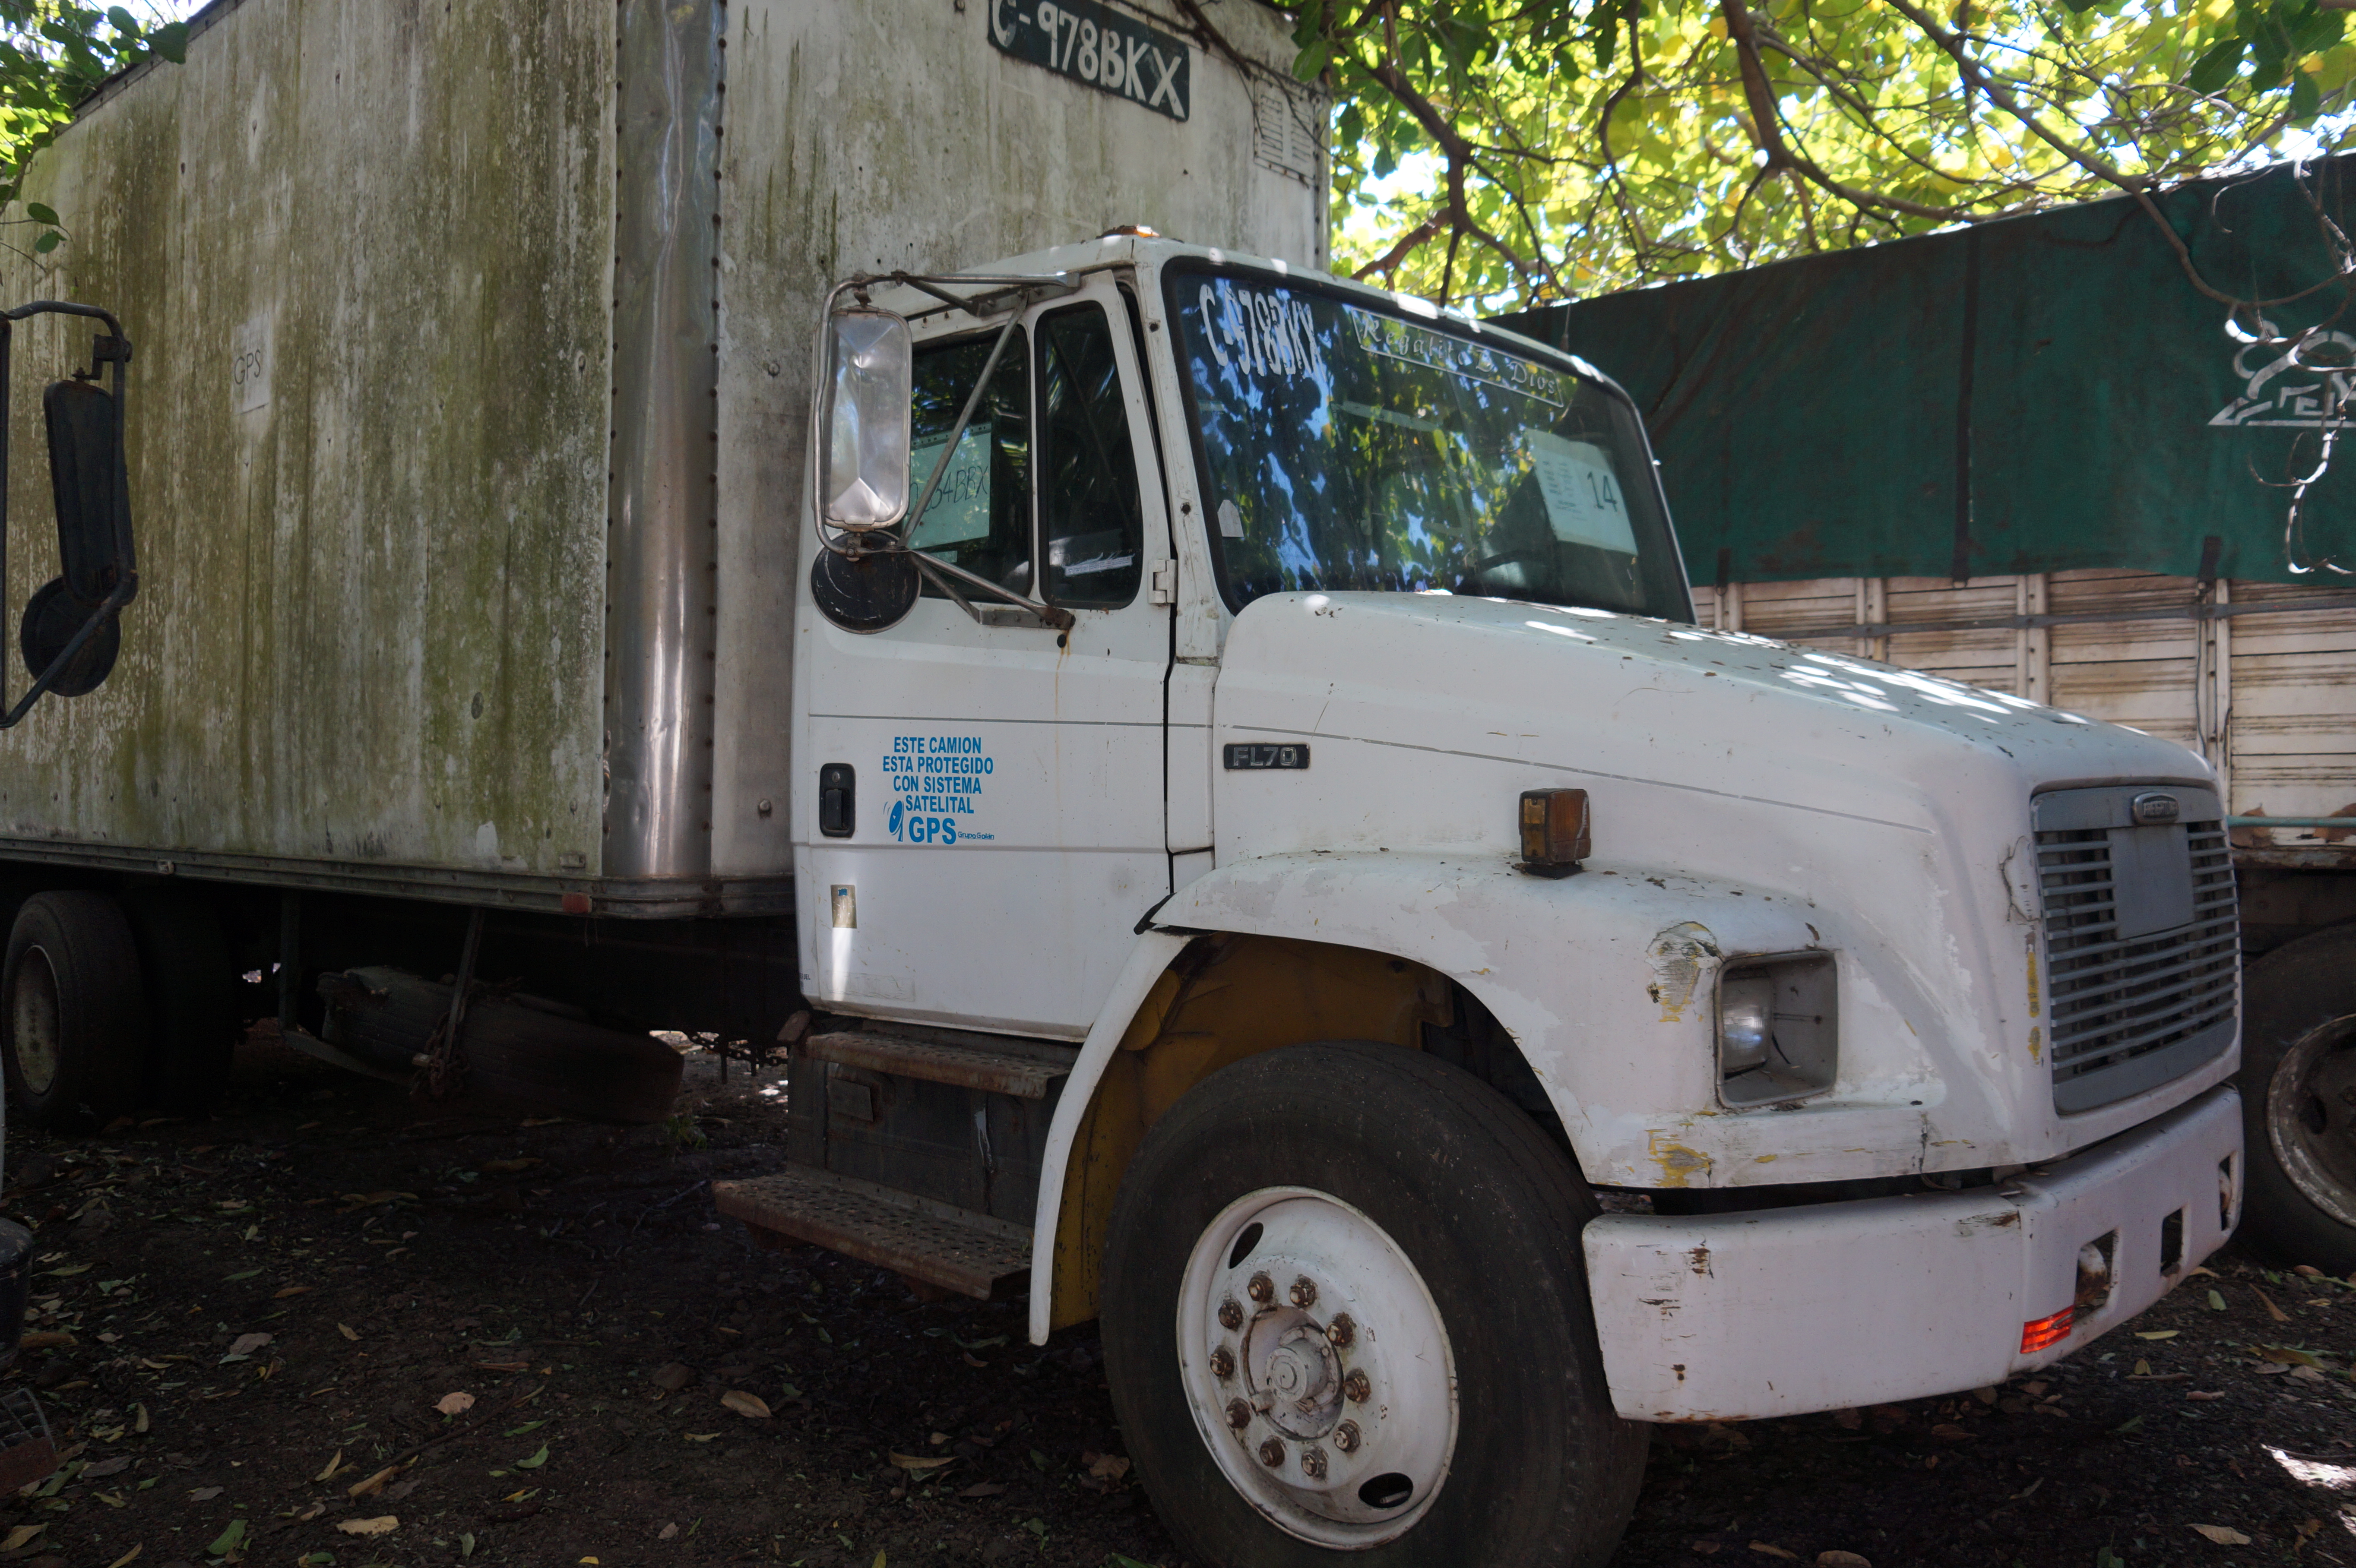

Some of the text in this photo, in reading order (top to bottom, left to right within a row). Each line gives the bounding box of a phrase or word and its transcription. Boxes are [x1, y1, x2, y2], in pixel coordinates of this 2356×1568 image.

[992, 0, 1186, 118] C-978BKX
[234, 350, 261, 385] GPS
[1507, 360, 1555, 394] Dios
[1587, 471, 1617, 512] 14
[894, 737, 981, 753] ESTE CAMION
[1234, 747, 1297, 766] FL70
[883, 756, 993, 774] ESTA PROTEGIDO
[893, 775, 982, 794] CON SISTEMA
[906, 795, 974, 813] SATELITAL
[909, 816, 956, 844] GPS
